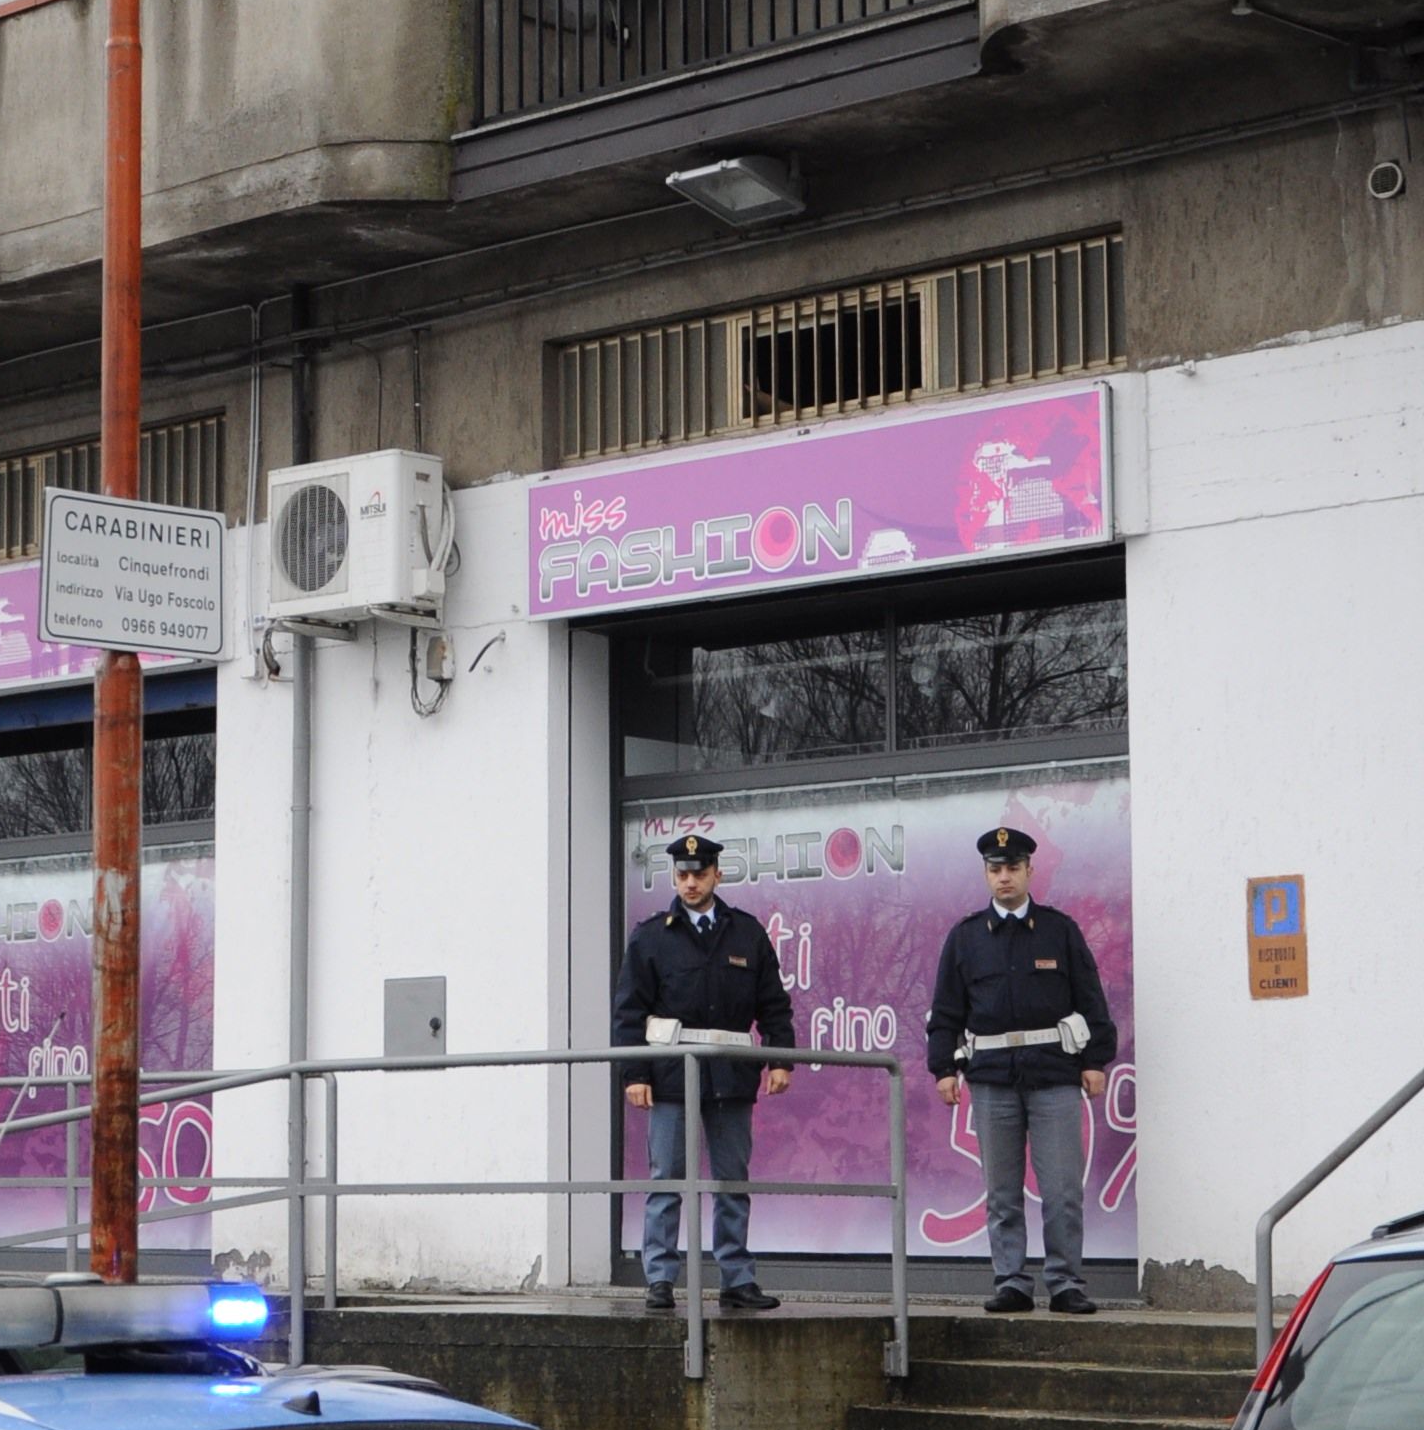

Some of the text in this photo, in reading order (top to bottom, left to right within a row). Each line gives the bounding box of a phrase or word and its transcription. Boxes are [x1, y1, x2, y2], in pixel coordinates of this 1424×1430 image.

[65, 511, 210, 549] CARABINIERI
[539, 491, 627, 541] miss
[57, 551, 209, 581] località Cinquefrondi
[539, 498, 853, 603] FASHION
[56, 581, 215, 611] indirizzo Via Ugo Foscolo
[54, 613, 208, 640] telefono 0966 949077
[644, 813, 715, 837] miss
[642, 824, 905, 891] FSHION
[810, 997, 897, 1070] fino
[29, 1038, 89, 1099] fino
